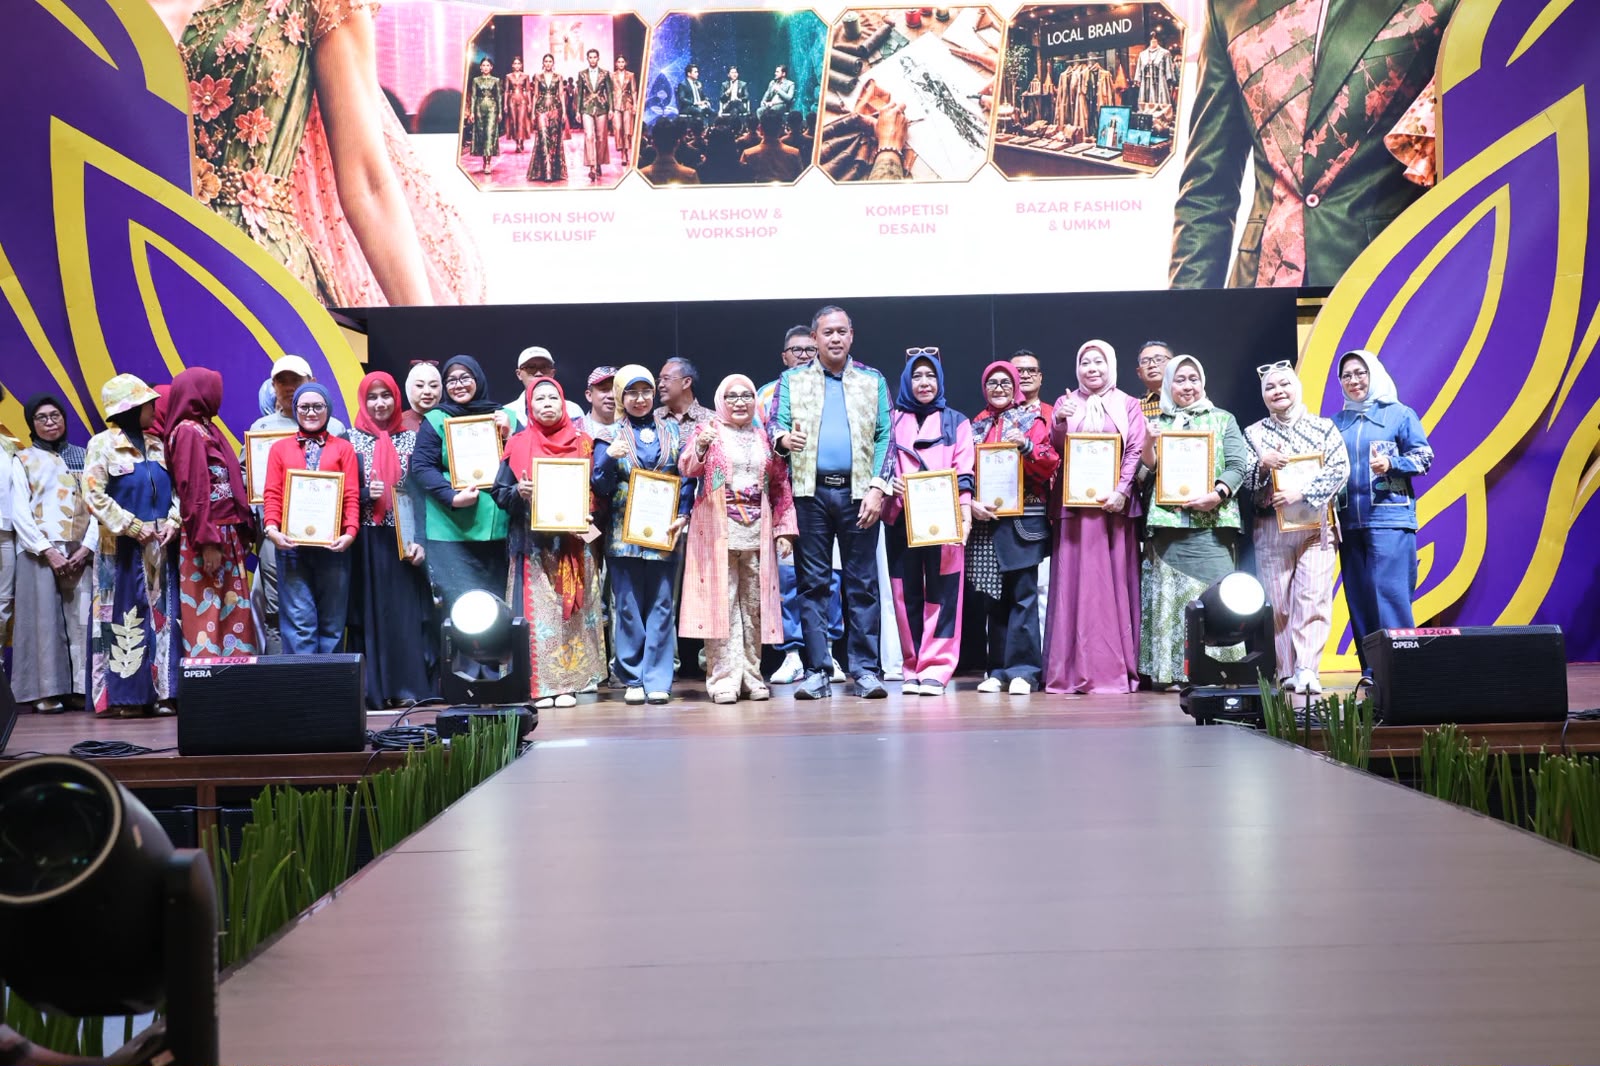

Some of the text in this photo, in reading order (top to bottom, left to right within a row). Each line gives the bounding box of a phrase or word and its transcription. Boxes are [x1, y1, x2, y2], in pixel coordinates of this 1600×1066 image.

[1047, 18, 1132, 46] LOCAL BRAND
[865, 204, 949, 217] KOMPETISI
[1016, 199, 1142, 214] BAZAR FASHION
[492, 211, 616, 225] FASHION SHOW
[680, 208, 783, 221] TALKSHOW &
[879, 223, 937, 235] DESAIN
[1049, 218, 1112, 231] & UMKM
[512, 230, 597, 243] EKSKLUSIF
[686, 226, 778, 239] WORKSHOP
[1392, 641, 1420, 649] OPERA
[184, 670, 212, 678] OPERA
